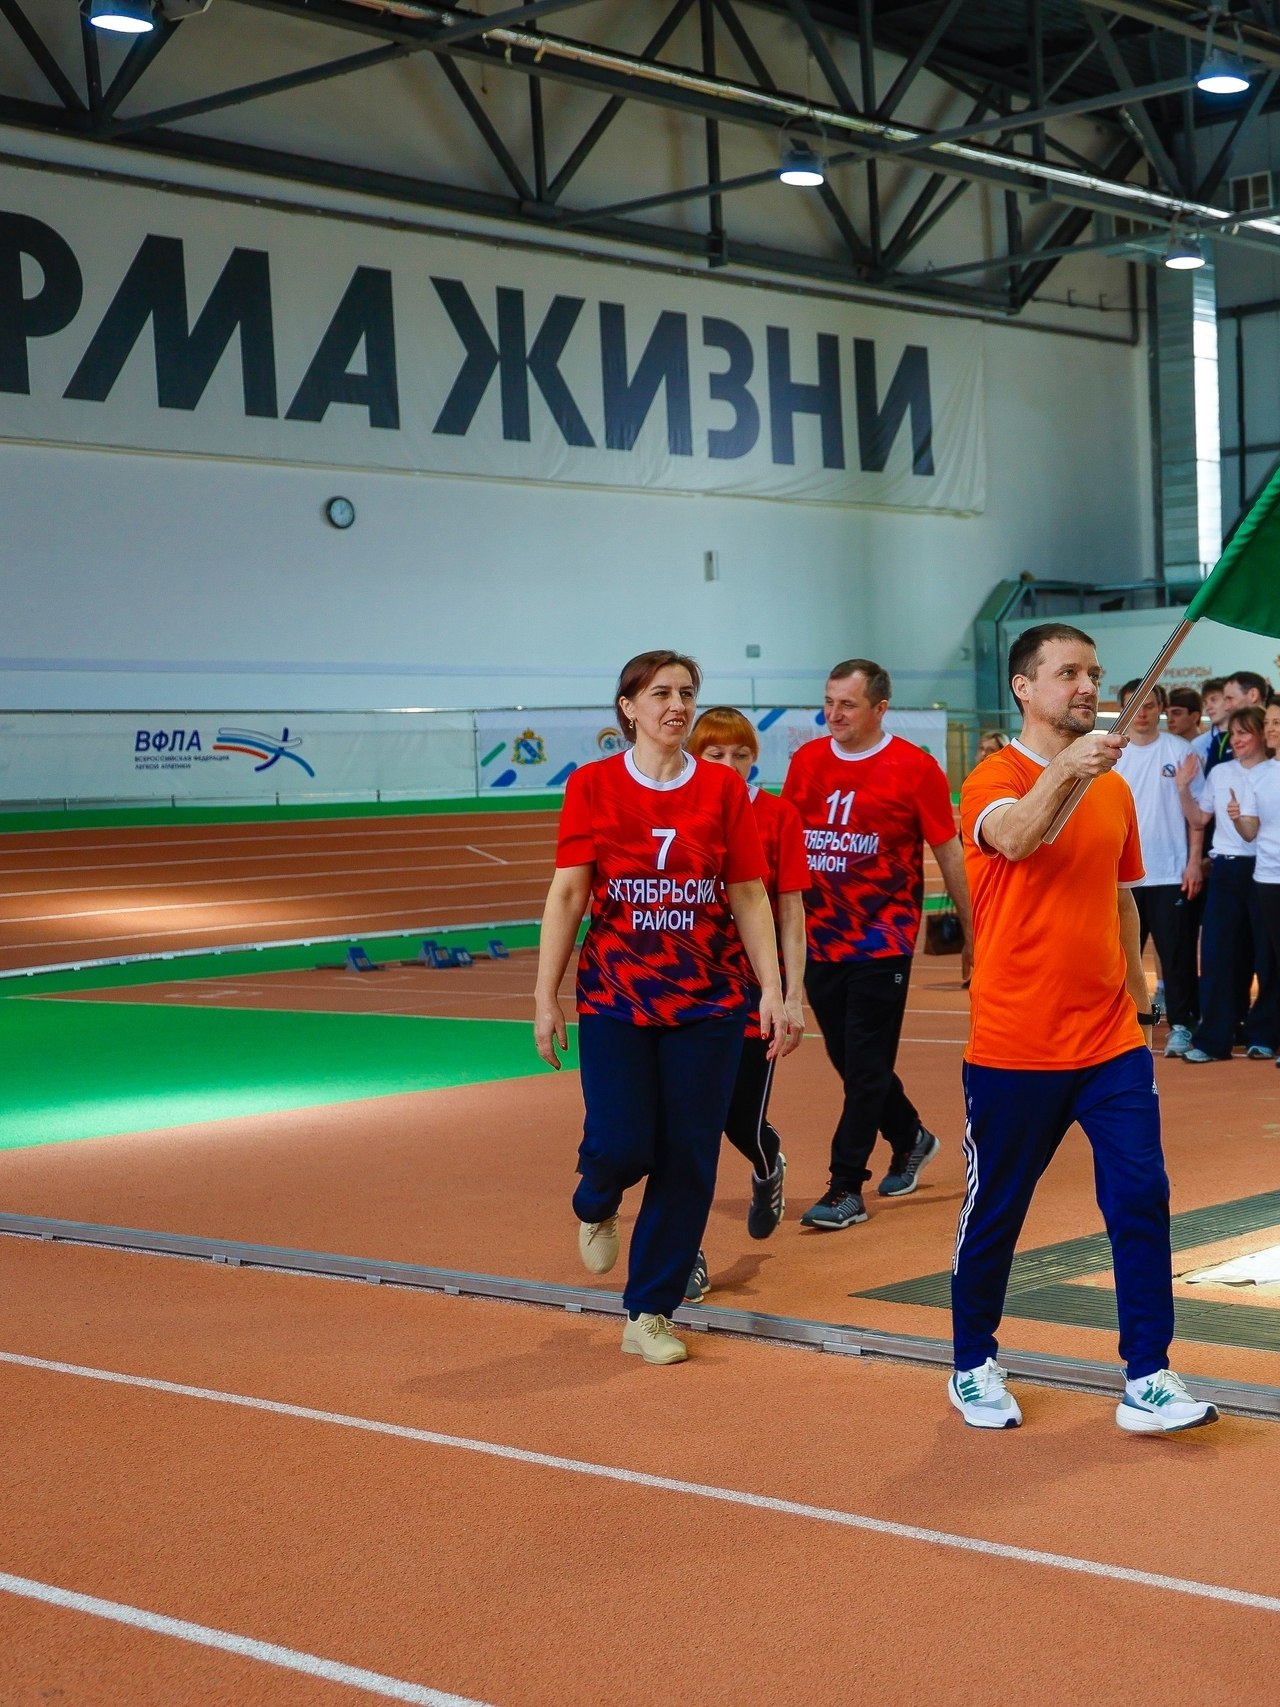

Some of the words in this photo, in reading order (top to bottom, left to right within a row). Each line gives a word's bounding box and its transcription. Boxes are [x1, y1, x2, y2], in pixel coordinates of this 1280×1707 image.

[430, 276, 935, 477] ЖИЗНИ
[134, 729, 202, 752] ВФЛА
[826, 790, 856, 825] 11
[651, 828, 677, 870] 7
[632, 906, 694, 931] РАЙОН
